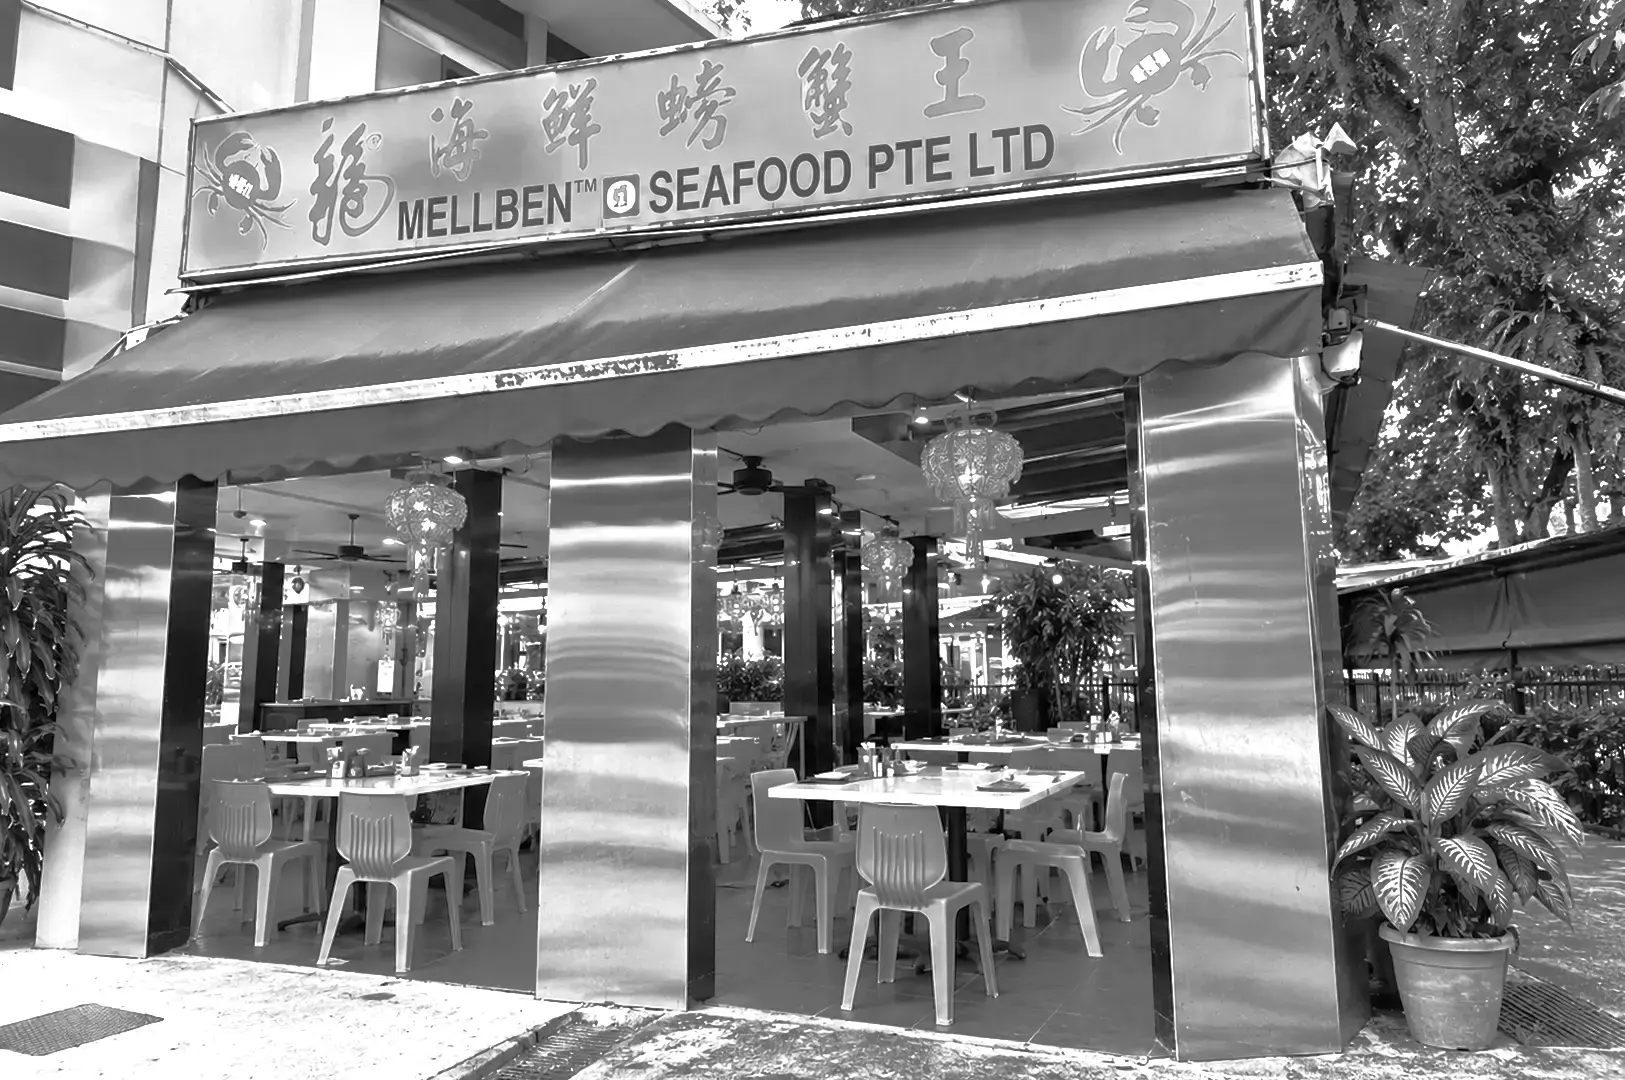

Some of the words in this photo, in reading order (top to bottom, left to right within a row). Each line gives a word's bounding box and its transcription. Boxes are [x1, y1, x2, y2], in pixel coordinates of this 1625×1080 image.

[648, 149, 852, 214] SEAFOOD
[868, 135, 953, 190] PTE
[968, 123, 1055, 178] LTD
